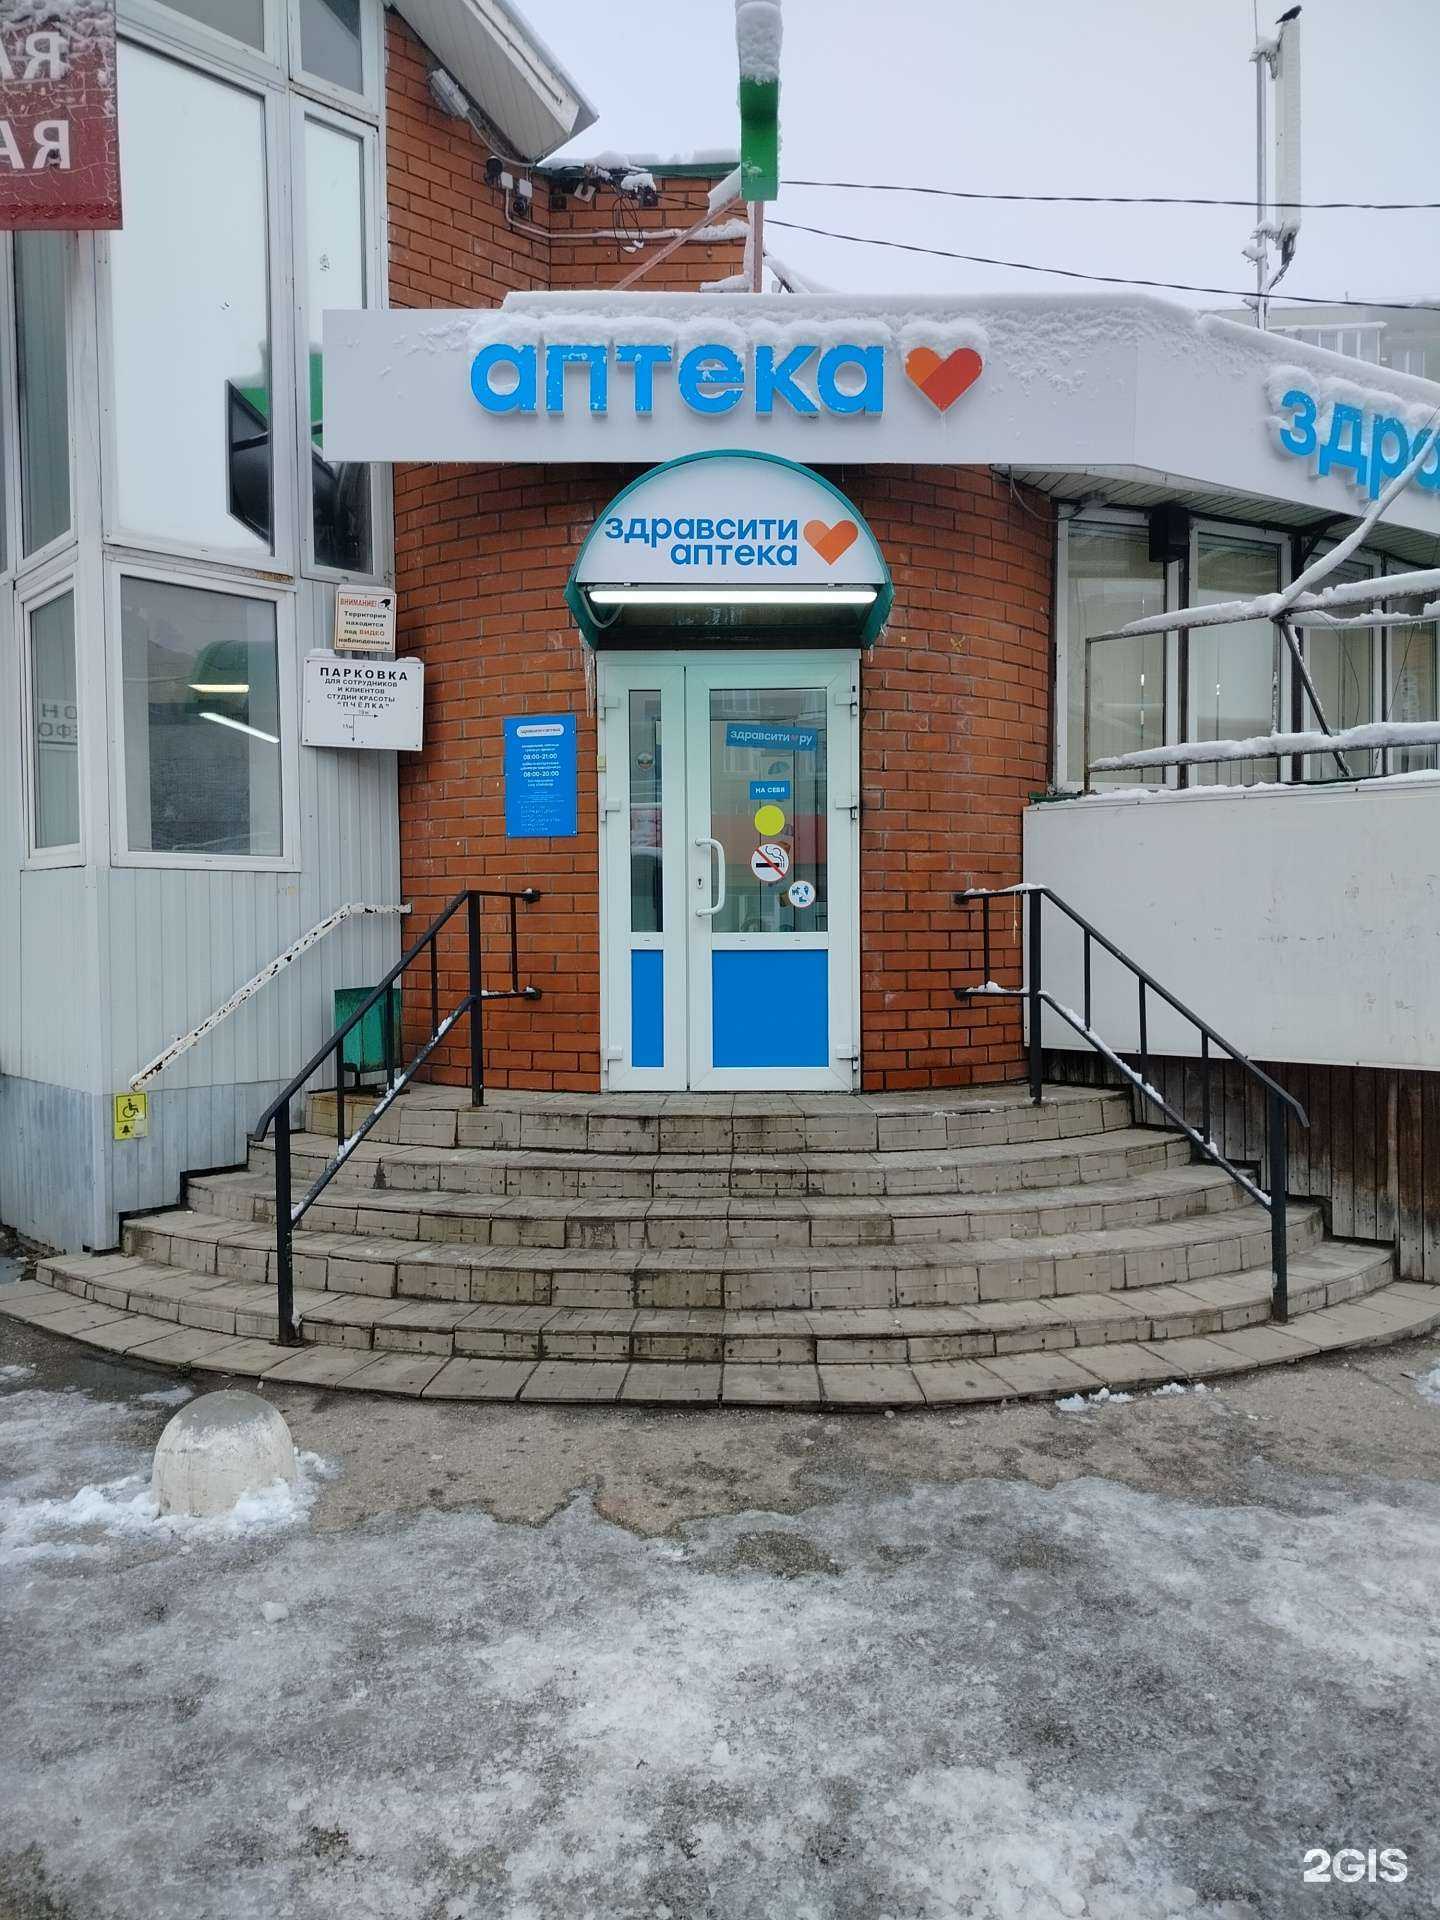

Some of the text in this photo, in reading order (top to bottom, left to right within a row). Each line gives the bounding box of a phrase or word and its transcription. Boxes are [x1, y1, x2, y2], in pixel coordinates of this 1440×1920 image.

[470, 342, 885, 416] аптека
[604, 517, 798, 548] здравсити
[670, 543, 798, 566] аптека
[344, 611, 387, 619] Территория
[319, 667, 408, 681] ПАРКОВКА
[342, 679, 398, 688] СОТРУДНИКОВ
[345, 687, 385, 695] КЛИЕНТОВ
[326, 693, 396, 703] СТУДИИ КРАСОТЫ
